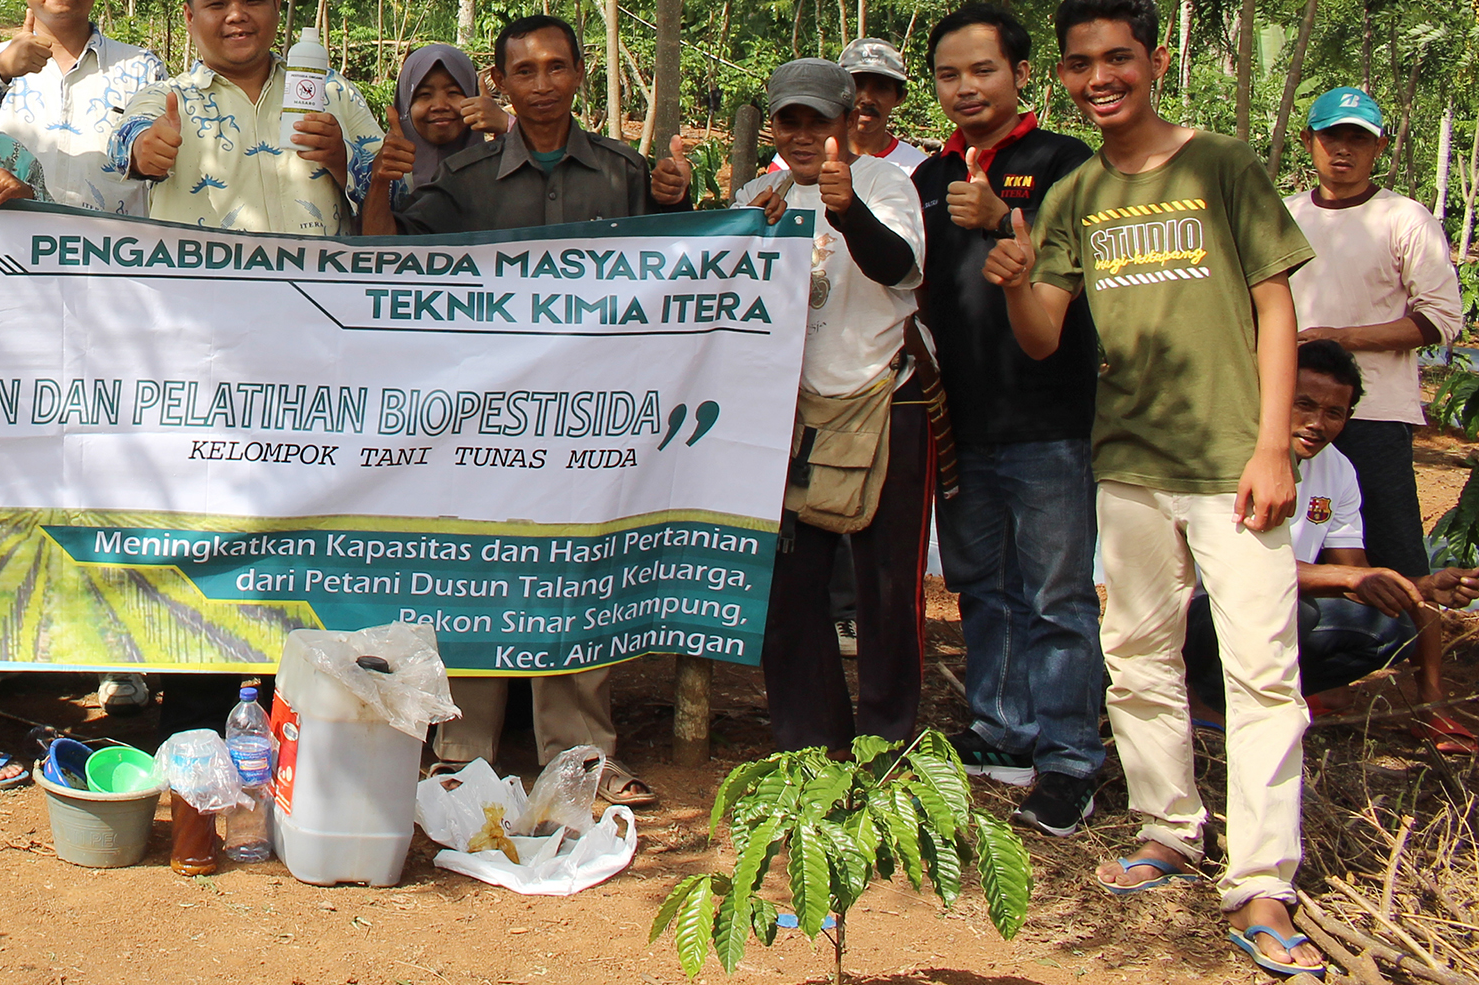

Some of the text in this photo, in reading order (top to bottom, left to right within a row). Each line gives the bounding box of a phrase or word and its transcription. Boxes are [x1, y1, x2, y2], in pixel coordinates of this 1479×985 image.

[1000, 189, 1030, 199] ITERA
[1004, 175, 1033, 187] KKN
[30, 234, 780, 281] PENGABDIAN KEPADA MASYARAKAT
[1090, 217, 1203, 261] STUDIO
[365, 289, 772, 325] TEKNIK KIMIA ITERA
[31, 378, 122, 425] DAN
[132, 379, 368, 434] PELATIHAN
[188, 440, 639, 469] KELOMPOK TANI TUNAS MUDA
[94, 526, 760, 564] Meningkatkan Kapasitas dan Hasil Pertanian
[235, 560, 753, 600] dari Petani Dusun Talang Keluarga,
[398, 595, 748, 634] Pekon Sinar Sekampung,
[494, 625, 746, 669] Kec. Air Naningan
